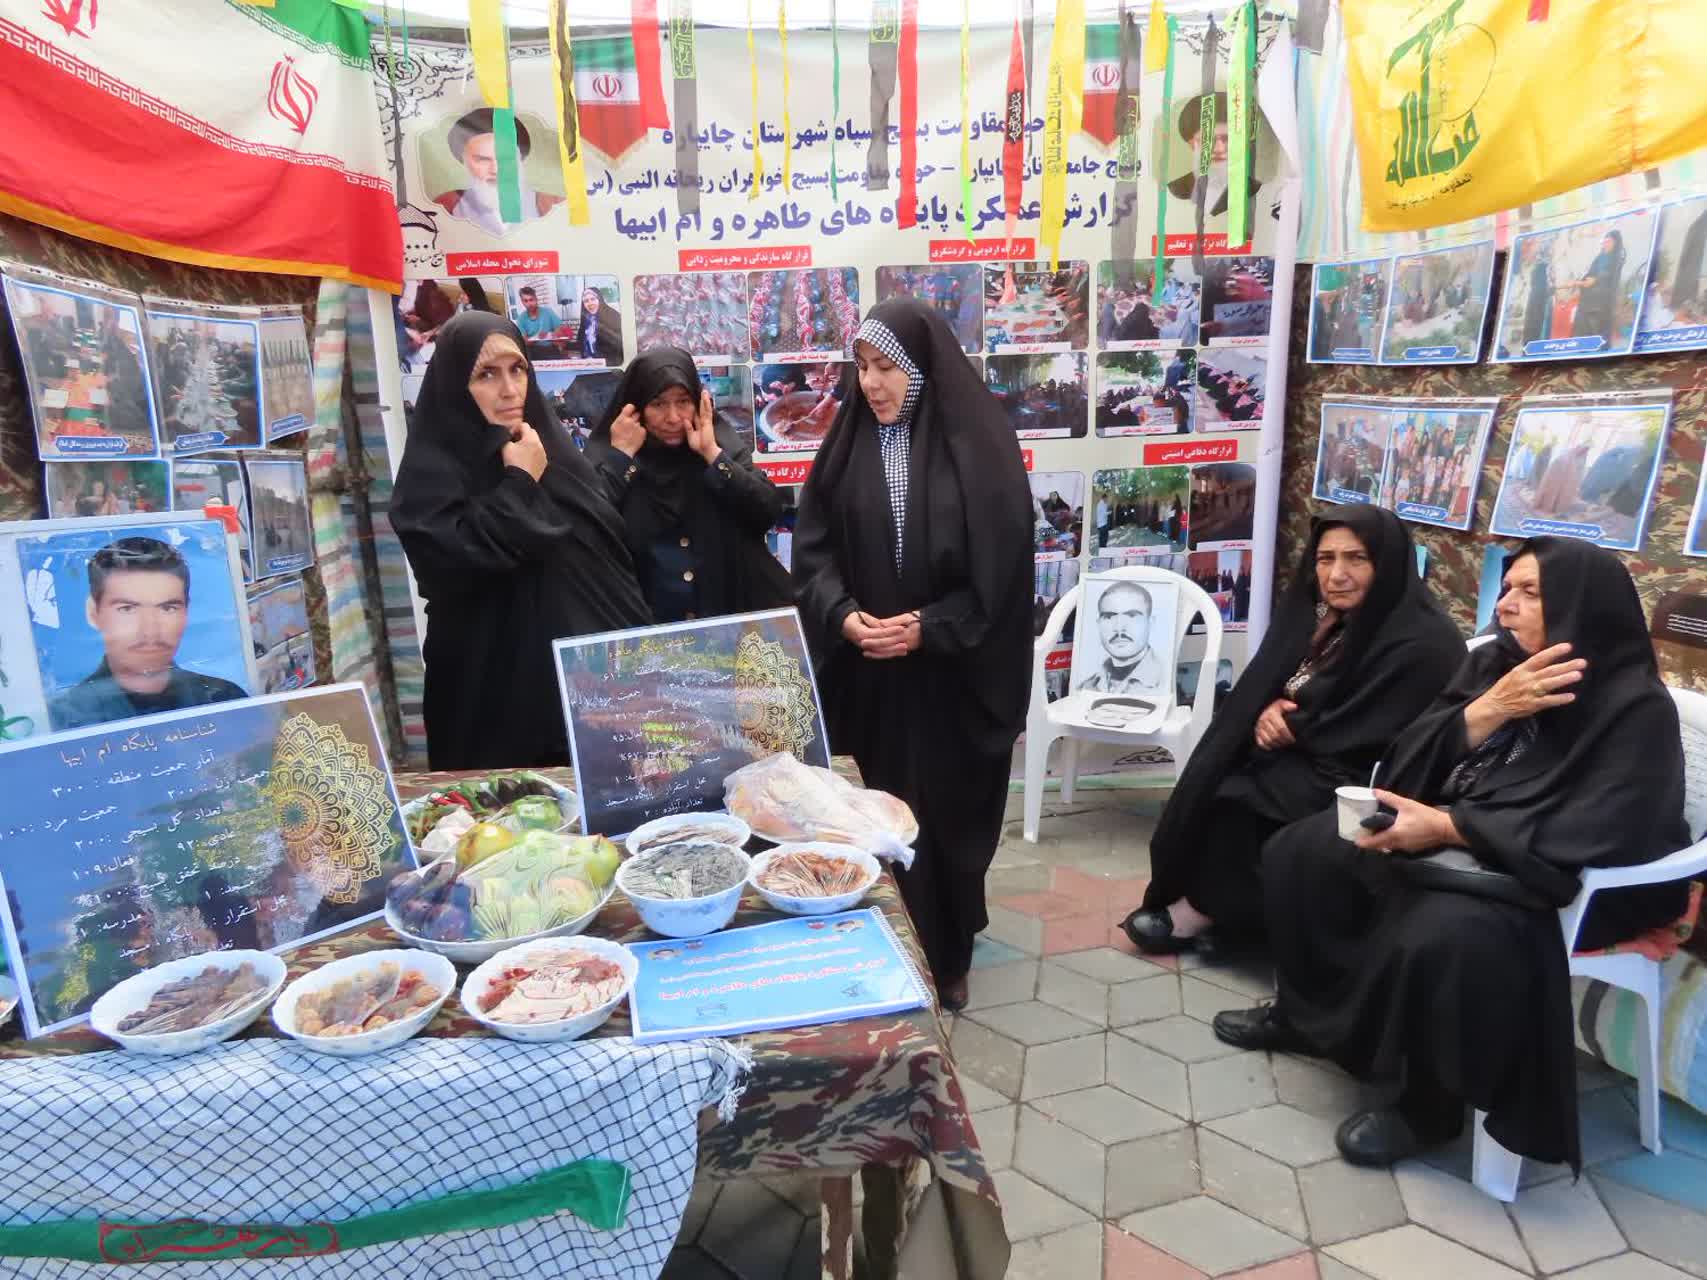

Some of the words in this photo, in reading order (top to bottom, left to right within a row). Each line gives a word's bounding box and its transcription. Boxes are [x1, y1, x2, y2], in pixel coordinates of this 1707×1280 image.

[885, 122, 928, 145] بج
[969, 157, 1005, 181] ایپار
[1065, 155, 1101, 179] جامع
[618, 168, 660, 195] النبی
[615, 207, 666, 240] ابیها
[676, 208, 700, 241] ام
[731, 201, 811, 240] طاهره
[820, 198, 872, 237] های
[879, 195, 947, 233] پایه
[955, 192, 1041, 233] عمکرد
[709, 217, 724, 241] و
[121, 728, 159, 754] پایگاه
[165, 721, 218, 744] شناسنامه
[149, 761, 188, 779] جمعیت
[195, 748, 216, 772] آمار
[107, 769, 142, 787] منطقه
[78, 804, 118, 822] جمعیت
